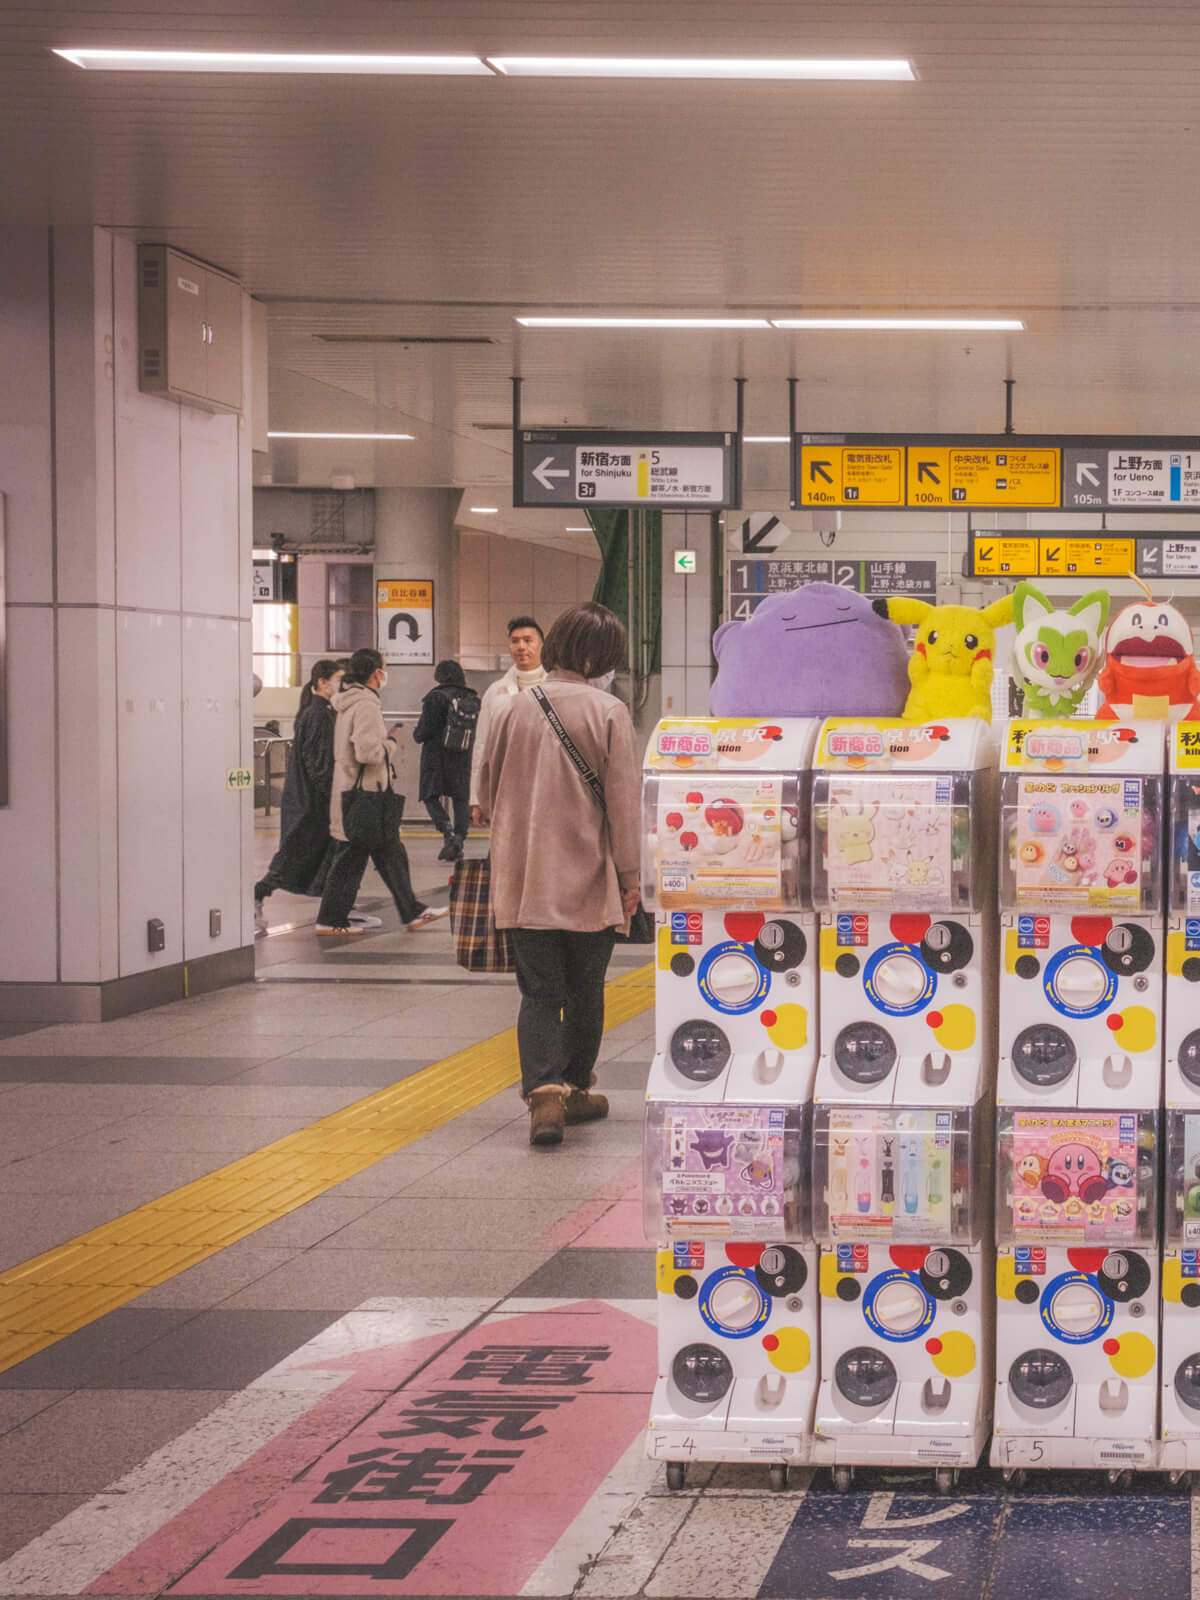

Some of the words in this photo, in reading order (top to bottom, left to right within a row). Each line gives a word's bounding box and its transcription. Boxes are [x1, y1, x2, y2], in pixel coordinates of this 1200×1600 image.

[581, 452, 631, 466] 新宿方面
[651, 451, 660, 465] 5
[847, 454, 892, 464] 電気街改札
[954, 454, 991, 465] 中央改札
[1113, 455, 1163, 471] 上野方面
[1185, 456, 1192, 469] 1
[581, 469, 593, 478] for
[595, 469, 632, 479] Shinjuku
[651, 467, 678, 476] 総武線
[1113, 473, 1128, 481] for
[1129, 473, 1154, 482] Ueno
[580, 483, 595, 498] 3F
[847, 489, 859, 500] 1F
[954, 490, 966, 501] 1F
[807, 492, 836, 503] 140m
[914, 493, 943, 503] 100m
[1073, 494, 1102, 505] 105m
[1165, 543, 1197, 553] 上野方面
[768, 562, 829, 574] 京浜東北線
[737, 565, 749, 589] 1
[837, 565, 856, 590] 2
[870, 563, 907, 575] 山手線
[871, 580, 931, 589] 上野・池袋方面
[660, 735, 710, 753] 新商品
[831, 735, 882, 753] 新商品
[1029, 738, 1080, 755] 新商品
[654, 1436, 697, 1457] F-4
[1006, 1439, 1044, 1463] F-5
[224, 1344, 612, 1580] 電気街口
